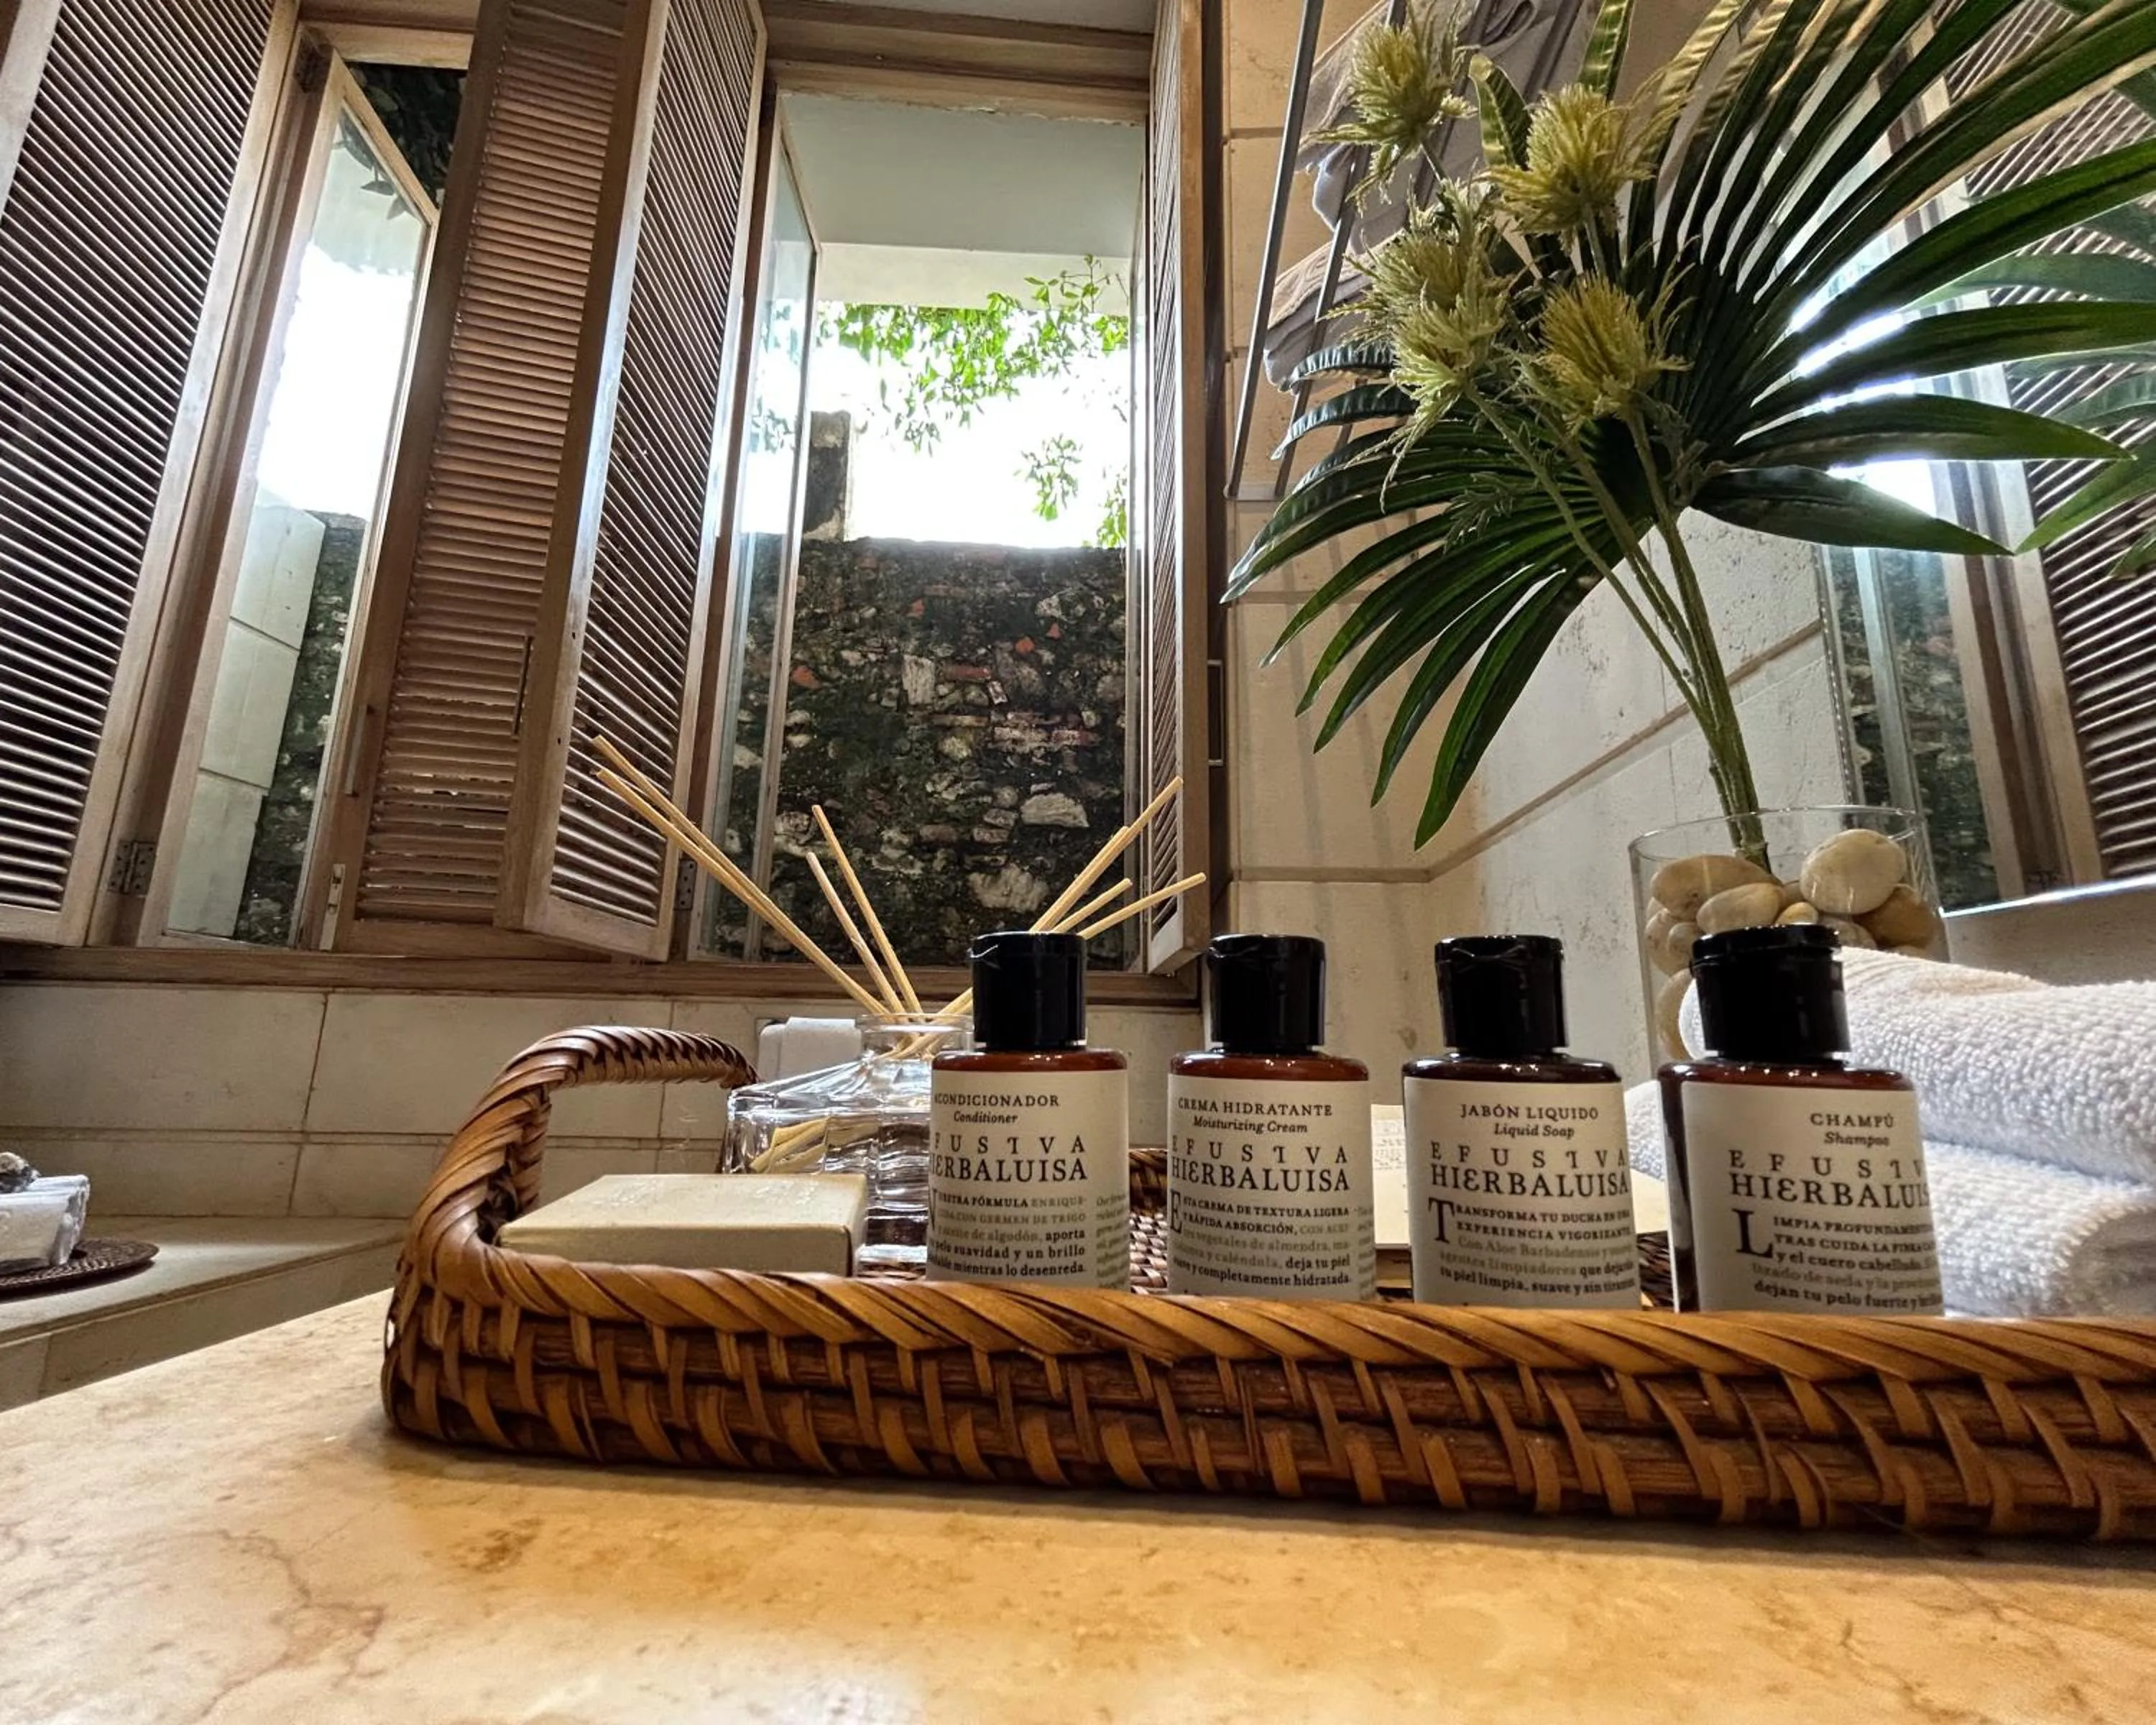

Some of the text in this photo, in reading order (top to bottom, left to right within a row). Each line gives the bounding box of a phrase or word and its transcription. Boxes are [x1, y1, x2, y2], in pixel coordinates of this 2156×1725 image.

[1179, 1097, 1332, 1117] CREMA HIDRATANTE
[1460, 1103, 1519, 1118] JABÓN
[954, 1110, 1018, 1123] Conditioner
[1194, 1115, 1307, 1135] Moisturizing Cream
[1810, 1113, 1894, 1128] CHAMPÚ
[1494, 1123, 1575, 1140] Liquid Soap
[1824, 1131, 1889, 1148] Shampoo
[1171, 1156, 1350, 1192] HIERBALUISA
[1431, 1163, 1628, 1197] HIERBALUISA
[972, 1195, 1028, 1208] FÓRMULA
[1237, 1205, 1250, 1215] DE
[1253, 1205, 1312, 1218] TEXTURA
[1314, 1207, 1350, 1218] LIGERA
[1539, 1212, 1558, 1223] TU
[1562, 1212, 1602, 1223] DUCHA
[1046, 1229, 1085, 1243] aporta
[1225, 1220, 1297, 1236] ABSORCIÓN,
[1457, 1221, 1553, 1240] EXPERIENCIA
[1774, 1233, 1815, 1247] TRAS
[1819, 1238, 1869, 1252] CUIDA
[1873, 1242, 1890, 1253] LA
[954, 1245, 1009, 1259] suavidad
[1014, 1250, 1021, 1261] y
[1026, 1248, 1044, 1259] un
[1048, 1244, 1085, 1259] brillo
[1776, 1252, 1786, 1264] y
[1789, 1251, 1804, 1264] el
[1808, 1256, 1856, 1269] cuero
[1006, 1263, 1018, 1276] lo
[1286, 1256, 1312, 1272] deja
[1316, 1258, 1329, 1269] tu
[1331, 1254, 1350, 1271] piel
[1198, 1266, 1291, 1285] completamente
[1580, 1266, 1601, 1279] que
[1531, 1282, 1570, 1293] suave
[1574, 1284, 1580, 1297] y
[1584, 1284, 1601, 1293] sin
[1754, 1280, 1799, 1298] dejan
[1804, 1289, 1821, 1302] tu
[1827, 1292, 1862, 1306] pelo
[1911, 1298, 1917, 1311] y
